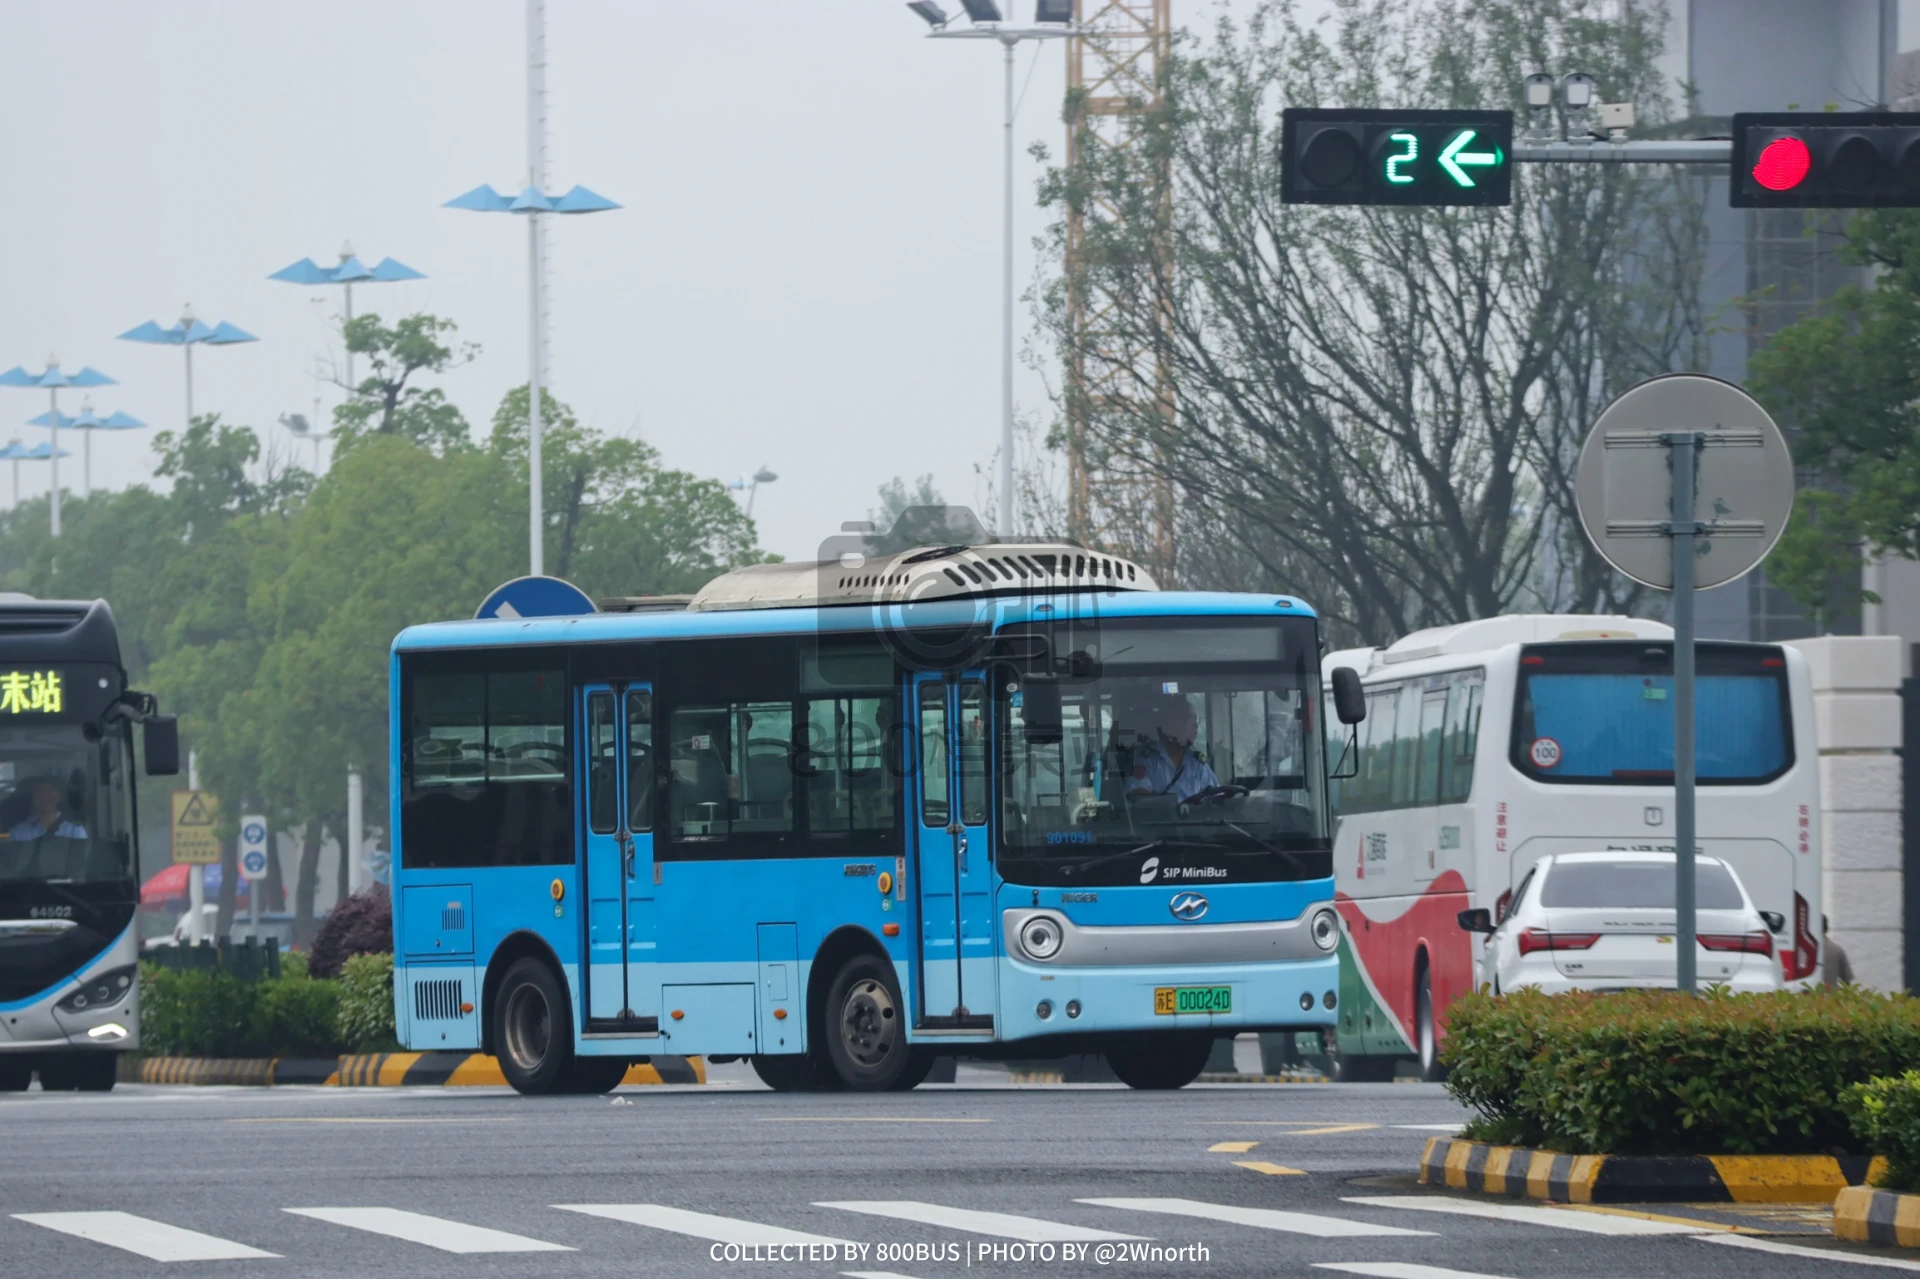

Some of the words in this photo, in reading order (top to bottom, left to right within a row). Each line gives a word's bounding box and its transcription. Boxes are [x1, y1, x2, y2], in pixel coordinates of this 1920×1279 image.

[1386, 132, 1418, 183] 2
[0, 669, 61, 714] 末站
[1535, 747, 1557, 759] 100
[1163, 867, 1180, 878] SIP
[1182, 866, 1228, 878] MiniBus
[1061, 892, 1098, 903] HIGER
